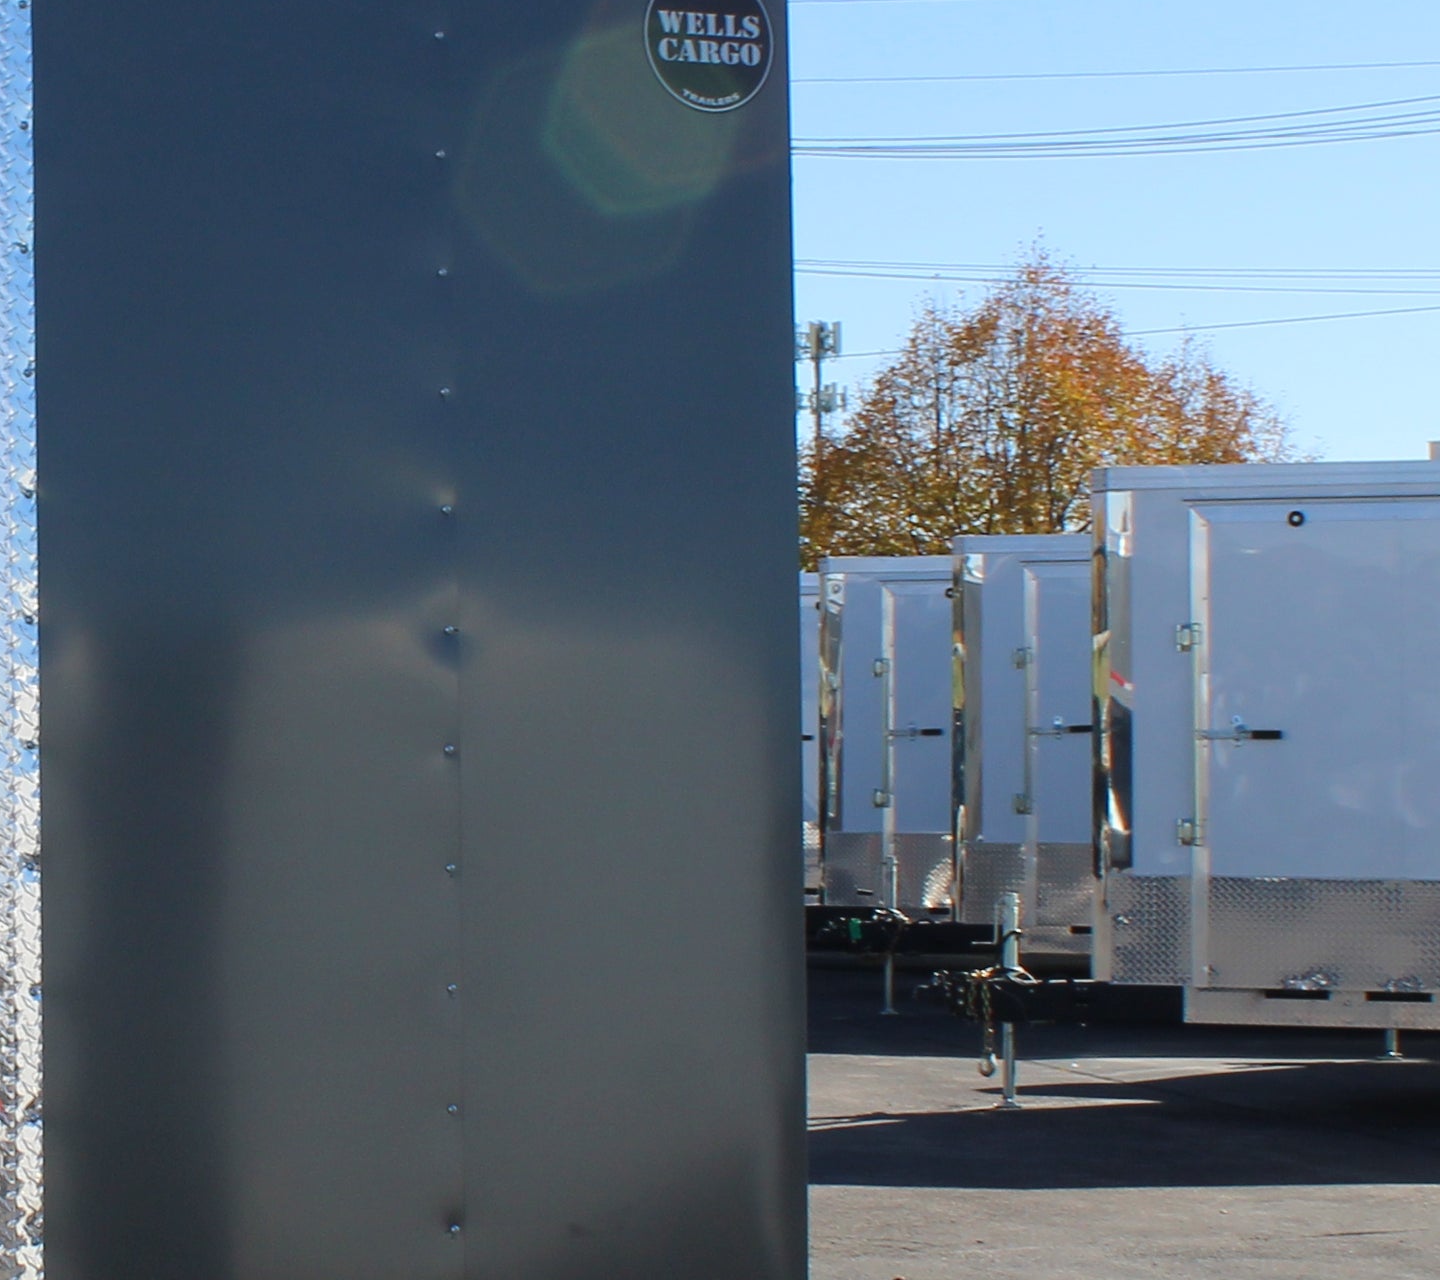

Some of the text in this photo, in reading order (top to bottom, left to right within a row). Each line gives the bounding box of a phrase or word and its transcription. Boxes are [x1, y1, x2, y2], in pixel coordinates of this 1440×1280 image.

[657, 9, 761, 39] WELLS
[658, 37, 761, 66] CARGO
[682, 88, 740, 106] TRAILERS
